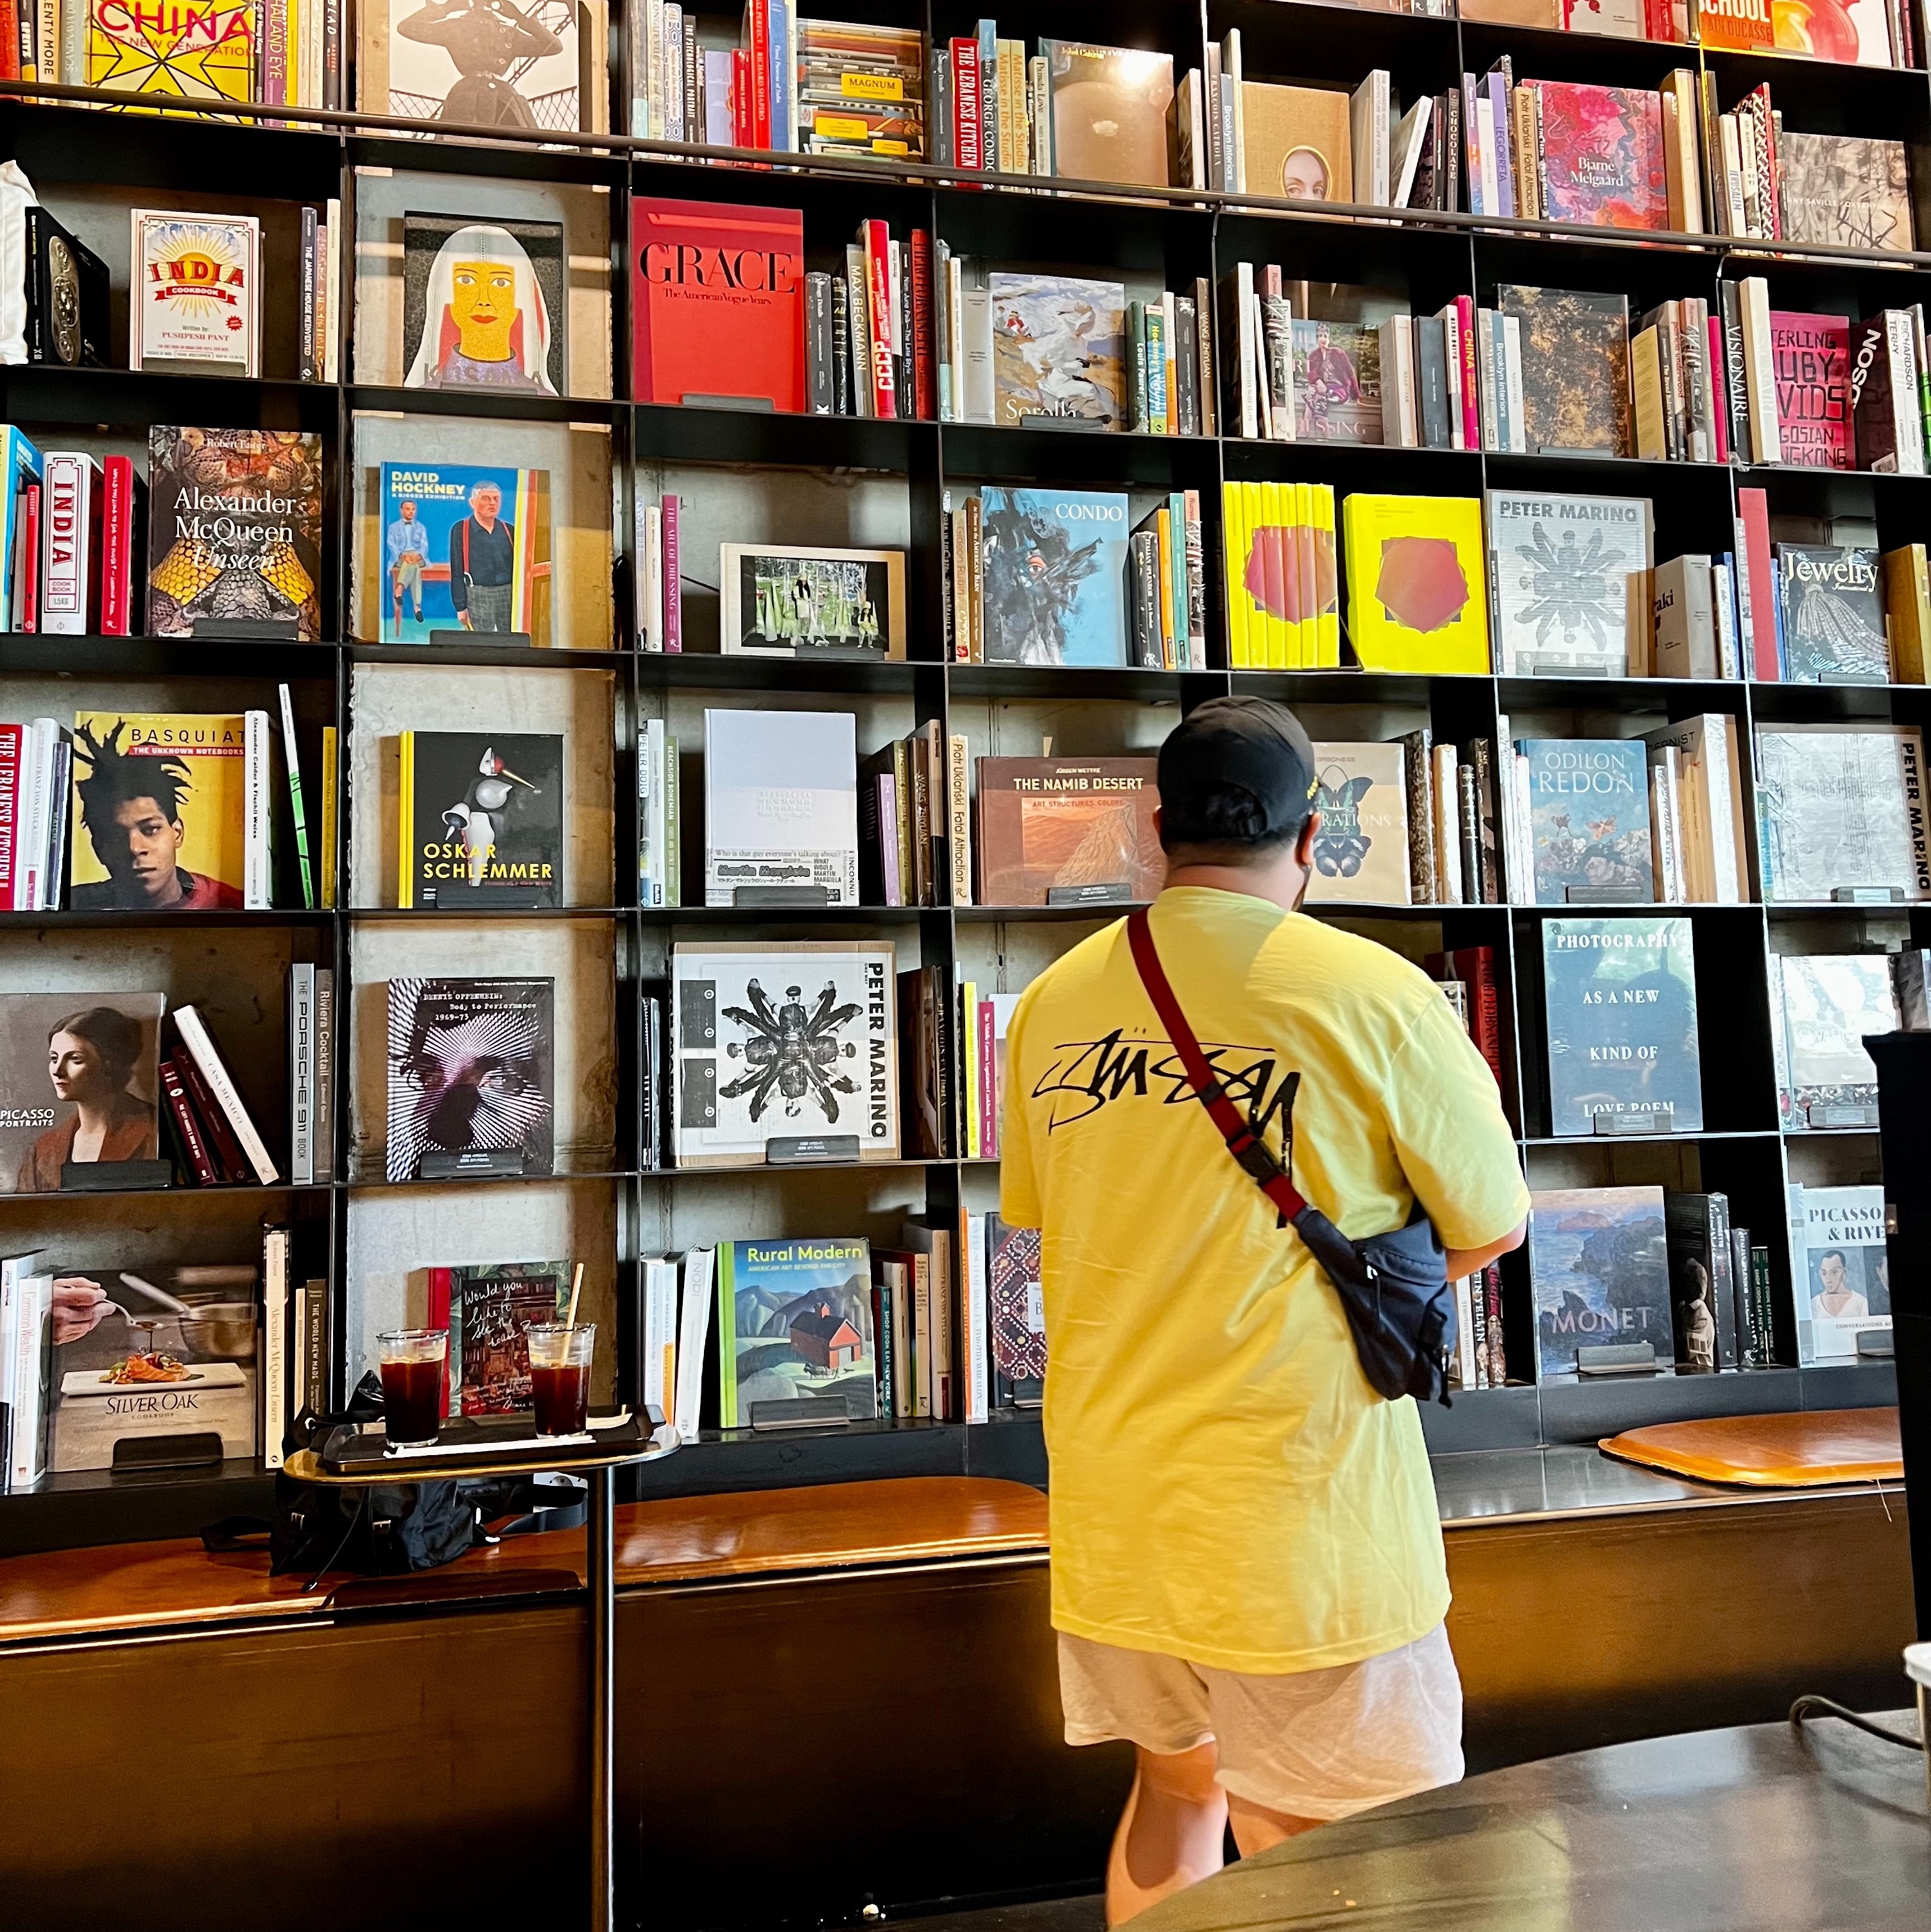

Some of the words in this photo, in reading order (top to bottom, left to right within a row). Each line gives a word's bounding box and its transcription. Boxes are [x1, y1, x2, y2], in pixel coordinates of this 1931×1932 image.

[97, 0, 255, 44] CHINA
[1699, 0, 1770, 23] CHOOL
[1701, 16, 1726, 33] AIN
[1727, 20, 1772, 41] DUCASSE
[130, 37, 162, 49] NEW
[167, 40, 255, 58] GENERATION
[957, 46, 975, 67] THE
[849, 78, 895, 90] MAGNUM
[959, 69, 977, 121] LEBANESE
[1520, 94, 1530, 114] Piotr
[1223, 105, 1233, 145] Brooklyn
[1522, 114, 1532, 148] Uklański
[960, 121, 979, 168] KITCHEN
[1495, 126, 1507, 182] LEGORRETA
[1225, 145, 1233, 181] Interiors
[1523, 153, 1534, 174] Fatal
[1578, 157, 1615, 172] Bjarne
[1571, 170, 1624, 187] Melgaard
[1730, 169, 1742, 211] JERUSALEM
[1525, 175, 1535, 216] Attraction
[147, 260, 245, 288] INDIA
[304, 259, 313, 292] JAPANESE
[639, 241, 795, 293] GRACE
[851, 265, 863, 293] MAX
[171, 287, 219, 296] COOKBOOK
[304, 293, 312, 315] HOUSE
[663, 287, 680, 298] The
[680, 289, 723, 302] American
[723, 292, 750, 306] Vogue
[750, 295, 772, 306] Years
[162, 332, 206, 340] PUSHPESH
[304, 315, 313, 356] REINVENTED
[852, 297, 867, 370] BECKMANN
[1199, 311, 1209, 338] WANG
[1670, 321, 1682, 351] patricia
[1151, 325, 1161, 372] Hockney's
[1464, 329, 1475, 369] CHINA
[1771, 329, 1837, 350] TERLING
[1888, 320, 1900, 355] TERRY
[874, 341, 895, 390] CCCP
[1136, 343, 1145, 367] Louis
[1200, 341, 1211, 378] ZHIYUAN
[1495, 342, 1507, 381] Brooklyn
[1900, 320, 1914, 391] RICHARDSON
[1137, 367, 1146, 394] Faurer
[1674, 353, 1684, 398] underwood
[1727, 324, 1749, 422] VISIONAIRE
[1152, 372, 1162, 411] Pictures
[1498, 381, 1507, 418] Interiors
[1665, 393, 1673, 415] Baker's
[1666, 415, 1674, 447] Apprentice
[391, 470, 439, 483] DAVID
[391, 481, 466, 496] HOCKNEY
[173, 486, 298, 514] Alexander
[1055, 503, 1122, 522] CONDO
[1499, 501, 1554, 518] PETER
[1559, 504, 1638, 522] MARINO
[51, 481, 76, 567] INDIA
[175, 515, 294, 547] McQueen
[194, 544, 277, 571] Unseen
[1785, 551, 1880, 594] Jewelry
[131, 728, 245, 745] BASQUIAT
[151, 747, 194, 755] UNKNOWN
[195, 747, 245, 757] NOTEBOOKS
[639, 735, 648, 766] PETER
[952, 743, 963, 764] Piotr
[1545, 752, 1626, 771] ODILON
[639, 770, 648, 794] DOIG
[1540, 771, 1635, 794] REDON
[1902, 742, 1921, 800] PETER
[953, 766, 966, 806] Uklański
[1013, 777, 1040, 791] THE
[1043, 777, 1089, 791] NAMIB
[1092, 777, 1144, 791] DESERT
[954, 811, 965, 834] Fatal
[1321, 813, 1391, 828] RATIONS
[423, 843, 496, 859] OSKAR
[738, 849, 752, 858] that
[752, 851, 764, 860] guy
[765, 849, 797, 859] everyone's
[798, 850, 820, 861] talking
[820, 850, 841, 859] about?
[954, 836, 965, 883] Attraction
[1909, 807, 1931, 891] MARINO
[423, 863, 553, 879] SCHLEMMER
[717, 864, 757, 877] Martin
[759, 865, 811, 879] Margiela
[1557, 933, 1680, 949] PHOTOGRAPHY
[298, 979, 308, 996] THE
[868, 962, 884, 1031] PETER
[1583, 990, 1603, 1005] AS
[1608, 990, 1620, 1005] A
[1623, 989, 1660, 1004] NEW
[449, 1003, 469, 1012] Body
[471, 1002, 482, 1010] to
[483, 1002, 538, 1012] Performance
[298, 1001, 308, 1105] PORSCHE
[1590, 1046, 1633, 1061] KIND
[1637, 1045, 1660, 1061] OF
[869, 1038, 887, 1138] MARINO
[0, 1108, 55, 1121] PICASSO
[298, 1109, 308, 1132] 911
[1583, 1103, 1626, 1118] LOVE
[1630, 1101, 1676, 1116] POEM
[0, 1119, 54, 1129] PORTRAITS
[297, 1138, 307, 1159] BOOK
[1809, 1206, 1882, 1223] PICASSO
[746, 1245, 791, 1263] Rural
[796, 1244, 861, 1262] Modern
[691, 1261, 703, 1297] NOPI
[1473, 1270, 1482, 1293] TIN
[464, 1283, 499, 1306] Would
[503, 1280, 522, 1300] you
[466, 1304, 497, 1327] like
[499, 1302, 512, 1313] to
[498, 1315, 513, 1327] the
[1475, 1297, 1486, 1341] YELLIN
[1552, 1304, 1652, 1334] MONET
[271, 1307, 280, 1348] Alexander
[311, 1318, 320, 1342] WORLD
[311, 1343, 320, 1359] NEW
[269, 1350, 280, 1392] McQueen
[311, 1360, 320, 1379] MADE
[105, 1395, 157, 1415] SILVER
[162, 1392, 200, 1410] OAK
[271, 1392, 280, 1422] Unseen
